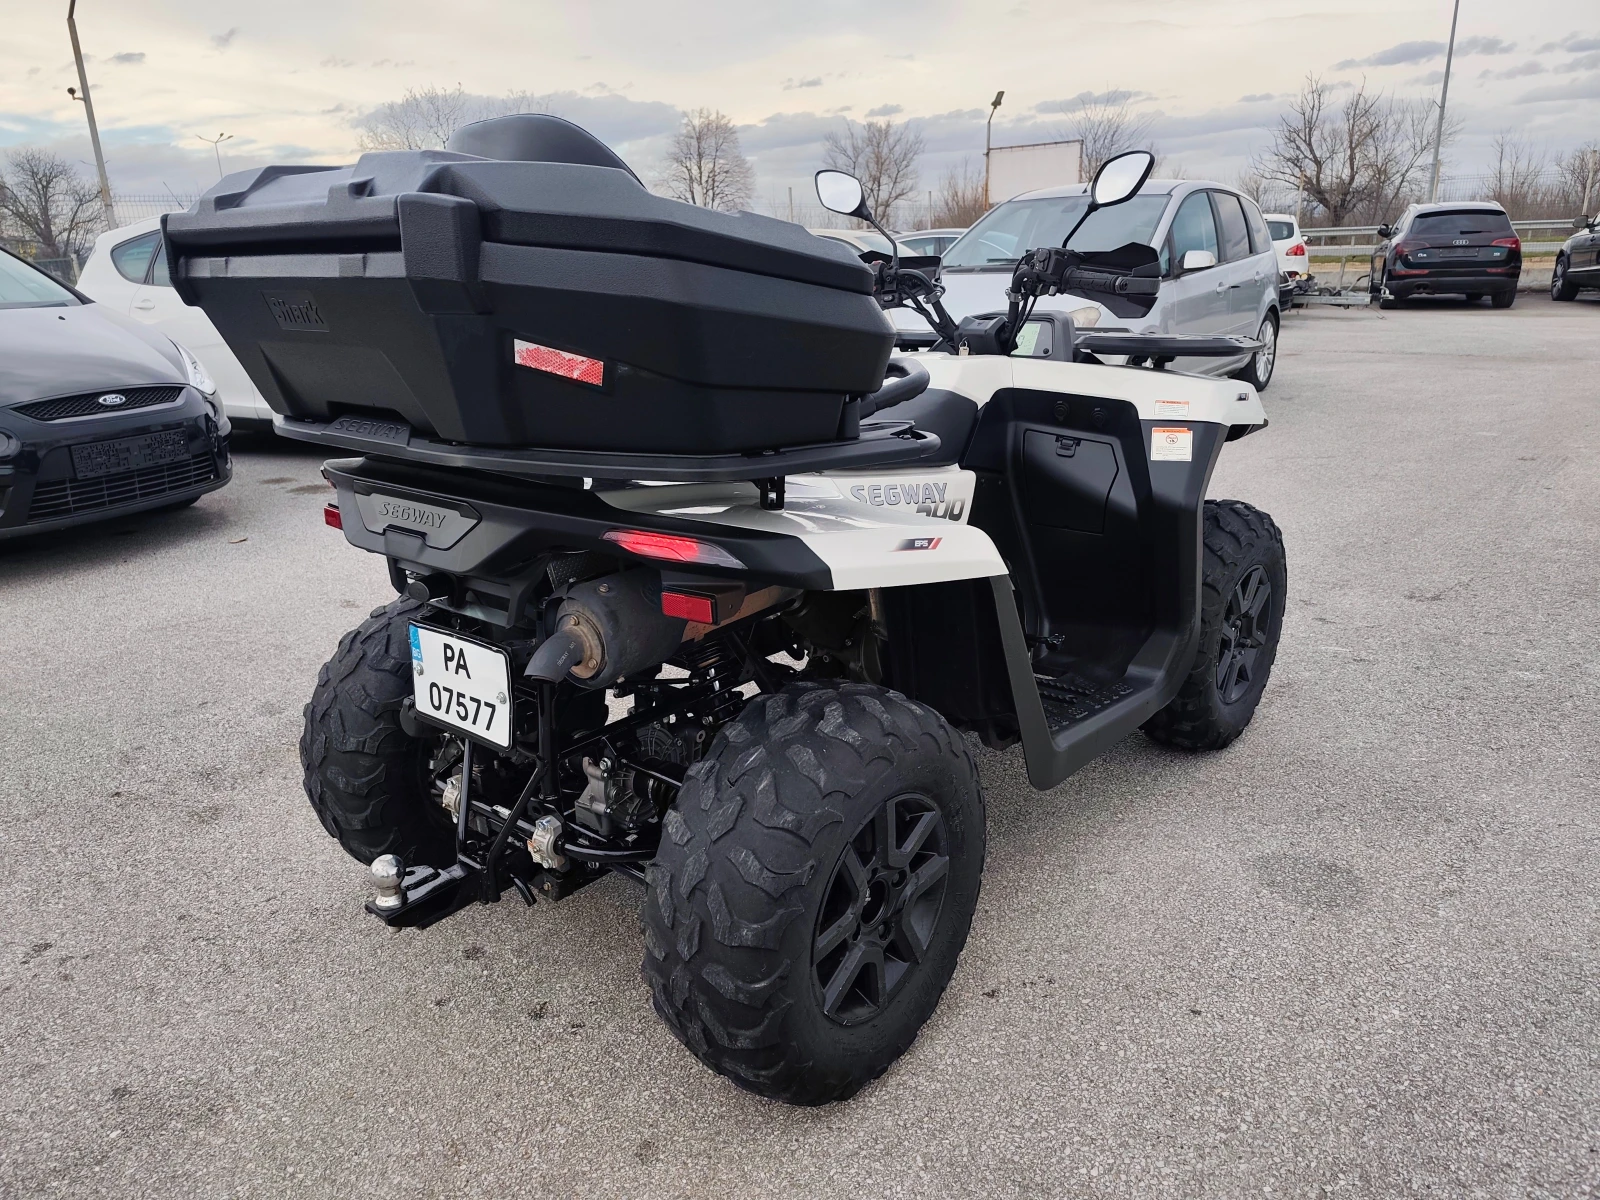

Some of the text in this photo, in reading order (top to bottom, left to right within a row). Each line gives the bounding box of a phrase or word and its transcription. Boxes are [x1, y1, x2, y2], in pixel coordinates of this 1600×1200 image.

[270, 296, 325, 325] Shark
[335, 418, 407, 439] SEGWAY
[850, 483, 947, 506] SEGWAY
[379, 502, 447, 528] SEGWAY
[443, 642, 471, 679] PA
[429, 681, 496, 732] 07577
